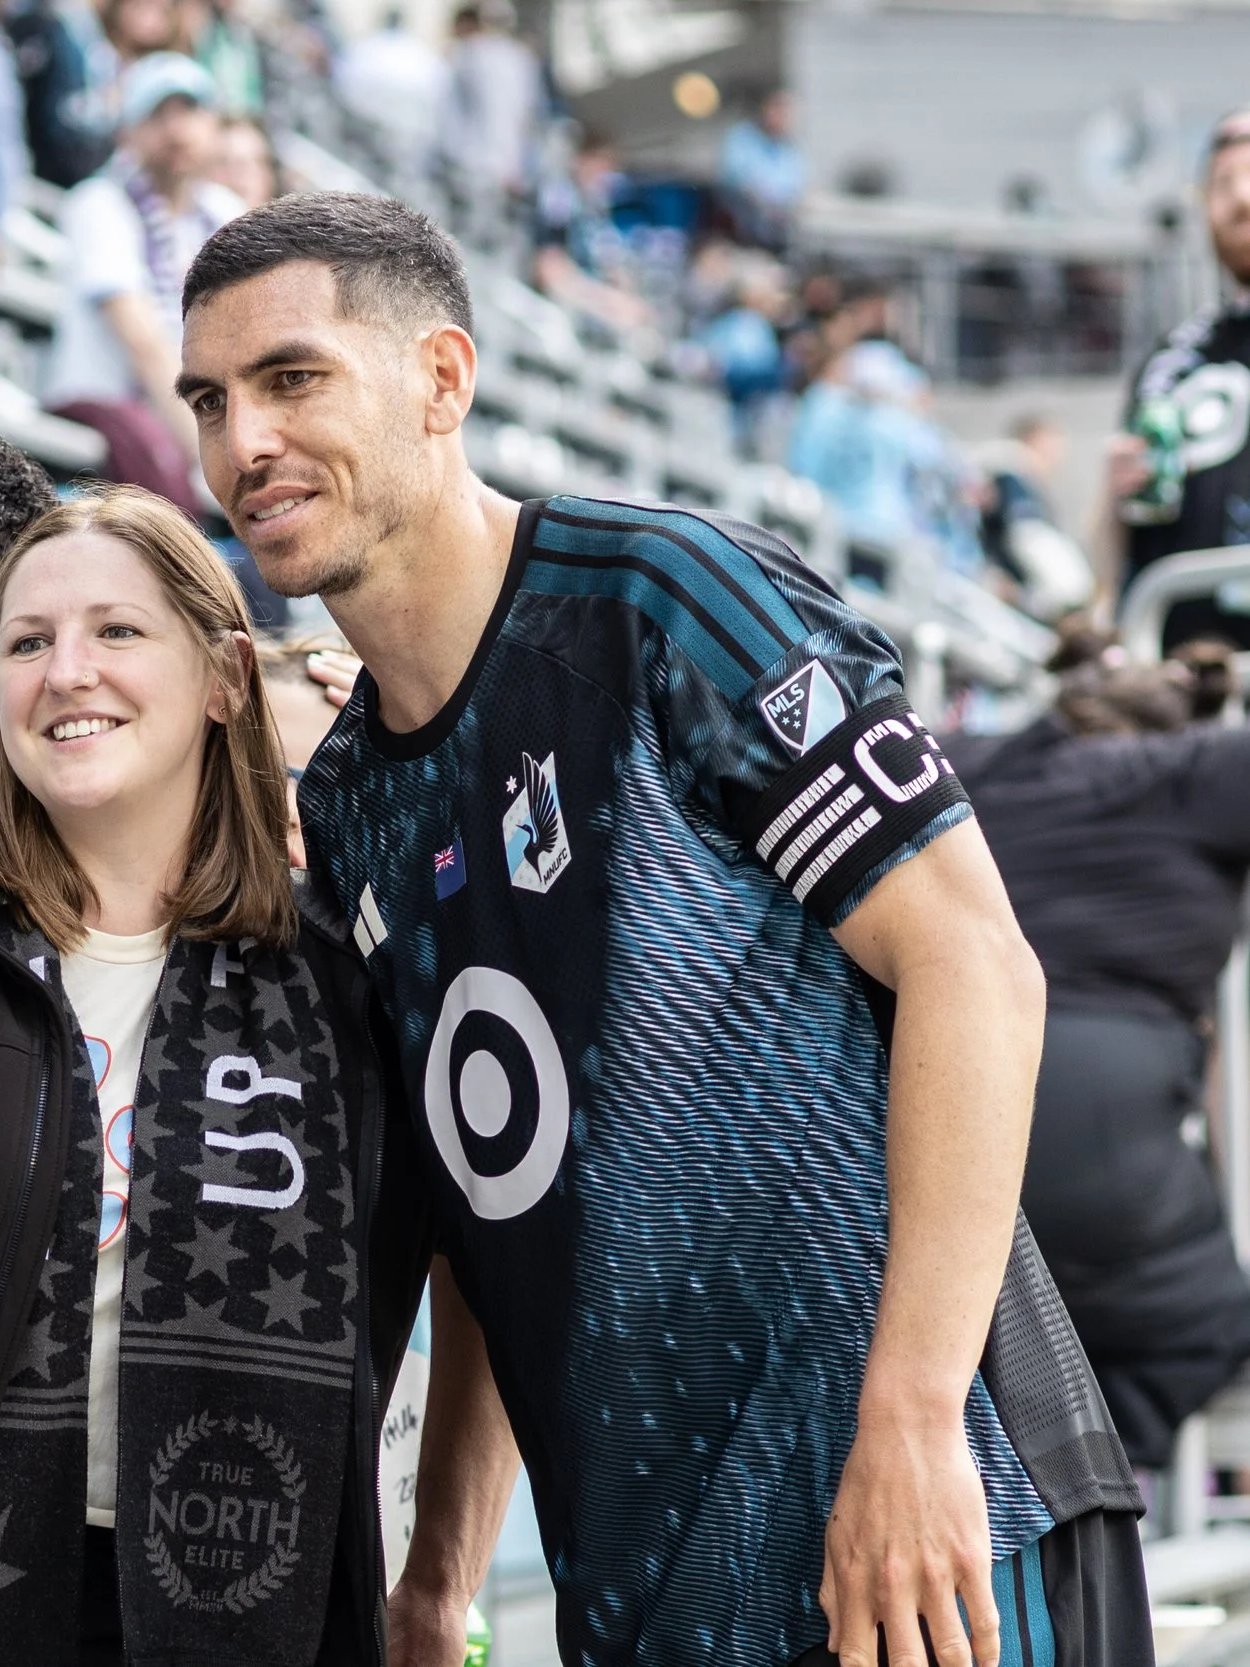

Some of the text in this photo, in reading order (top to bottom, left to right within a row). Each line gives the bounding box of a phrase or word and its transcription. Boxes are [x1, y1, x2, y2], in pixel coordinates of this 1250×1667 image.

[768, 683, 806, 719] MLS
[854, 719, 939, 803] C
[543, 848, 568, 885] MNUFC
[199, 1462, 254, 1486] TRUE
[148, 1489, 301, 1548] NORTH
[184, 1546, 245, 1570] ELITE
